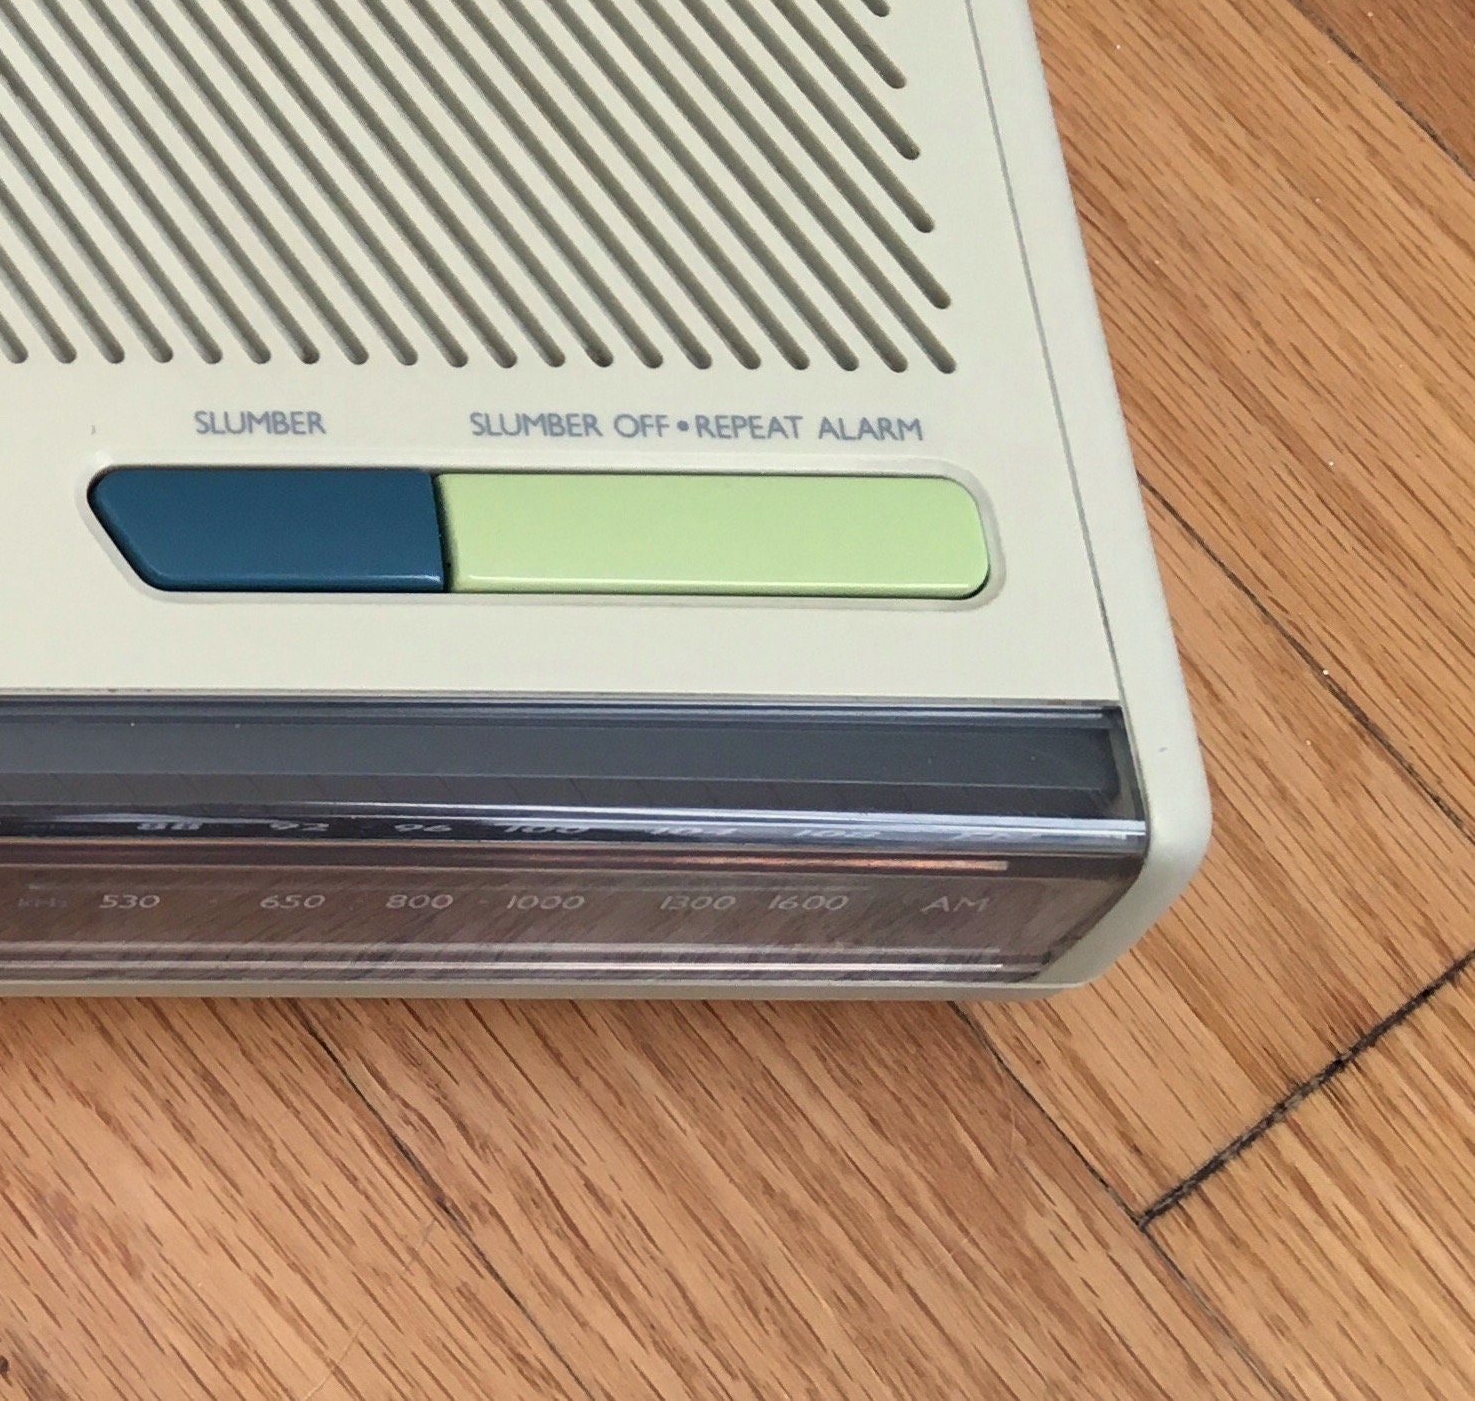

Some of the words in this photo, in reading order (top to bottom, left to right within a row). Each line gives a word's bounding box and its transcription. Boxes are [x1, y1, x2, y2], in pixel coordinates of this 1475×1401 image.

[194, 412, 326, 435] SLUMBER
[470, 413, 602, 437] SLUMBER
[817, 417, 925, 441] ALARM
[99, 894, 161, 909] 530
[260, 894, 326, 910] 650
[385, 894, 454, 910] 800
[505, 894, 585, 910] 1000
[767, 895, 849, 911] 1600
[920, 895, 991, 912] AM
